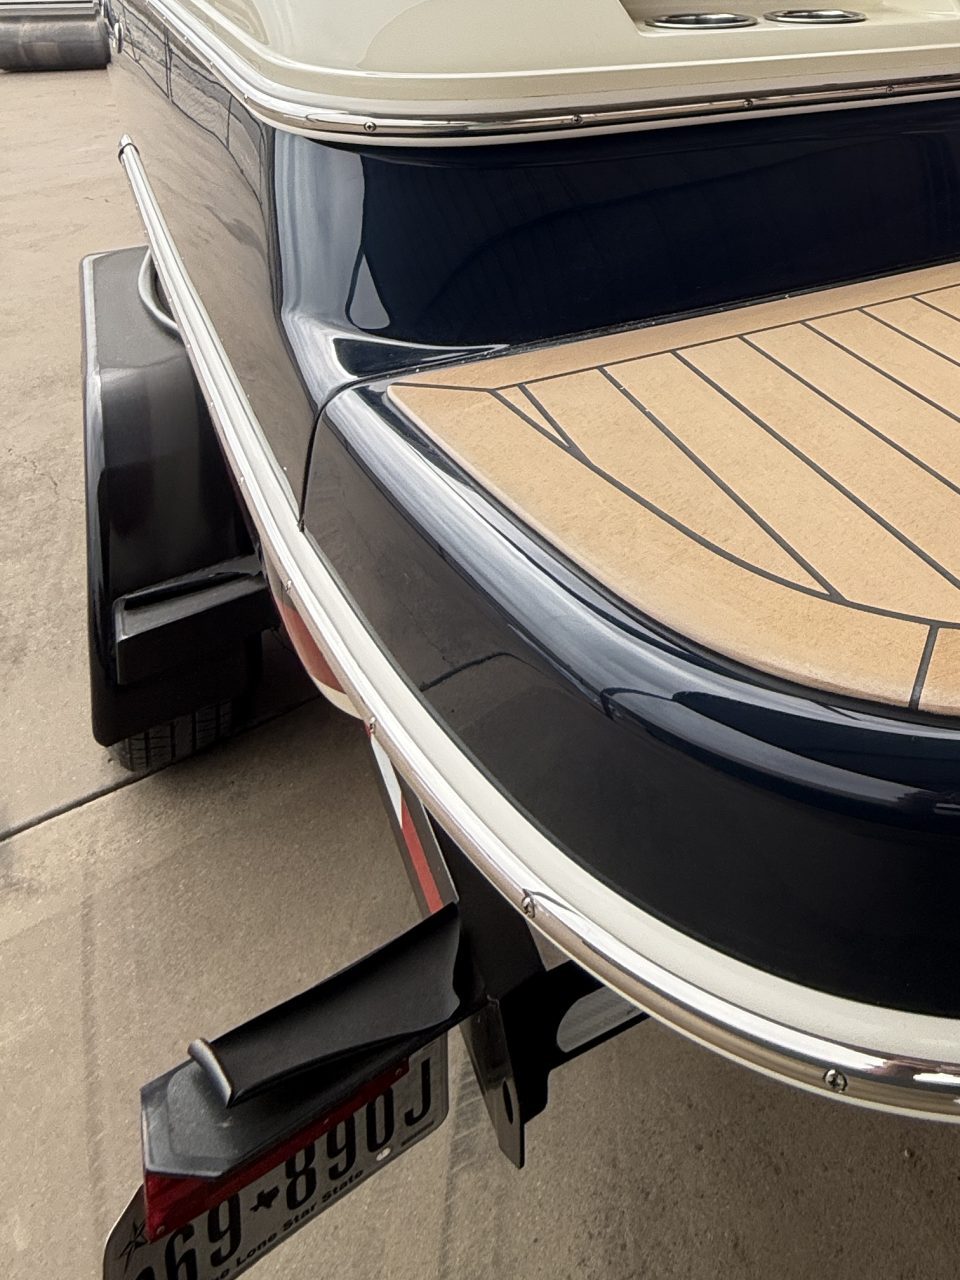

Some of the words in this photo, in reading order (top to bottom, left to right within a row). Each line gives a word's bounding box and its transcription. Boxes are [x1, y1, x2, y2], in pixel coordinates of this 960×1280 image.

[134, 1191, 242, 1280] 69
[285, 1057, 432, 1210] 890J
[236, 1232, 278, 1267] Lone
[283, 1202, 318, 1232] Star
[321, 1169, 364, 1202] State
